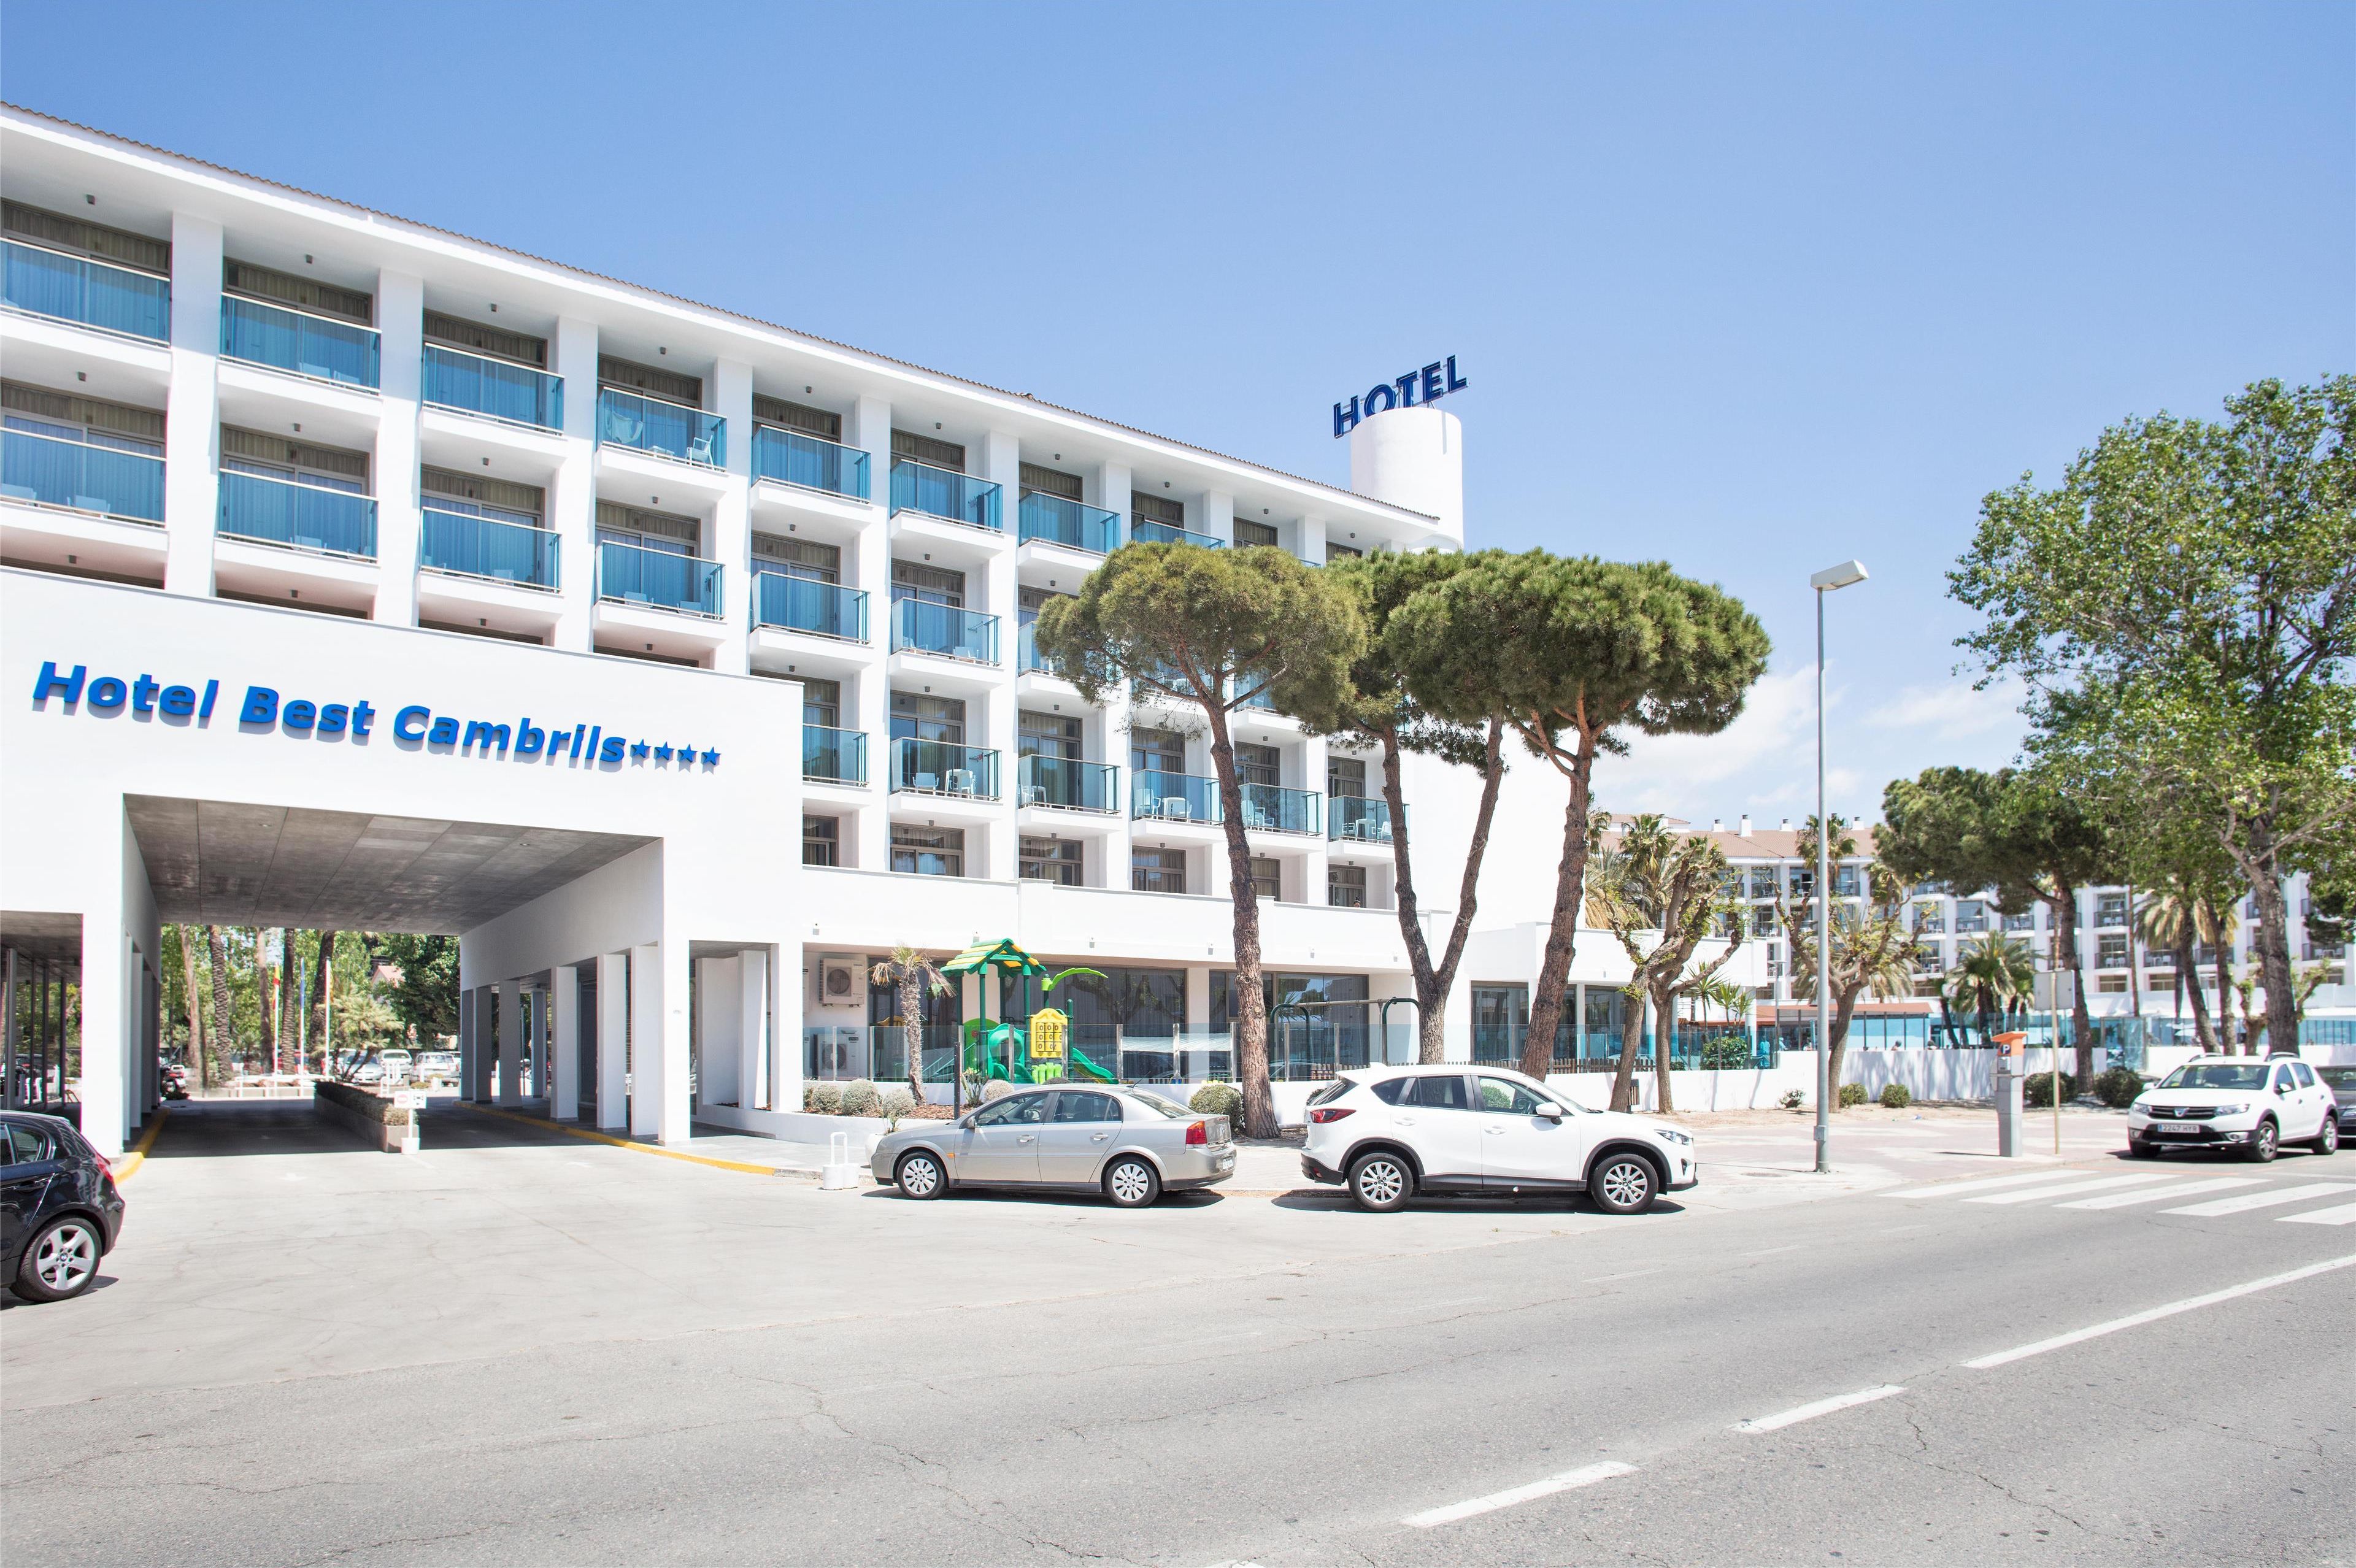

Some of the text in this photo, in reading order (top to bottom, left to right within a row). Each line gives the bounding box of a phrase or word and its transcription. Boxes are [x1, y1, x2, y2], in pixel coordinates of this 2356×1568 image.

[1333, 354, 1469, 439] HOTEL
[32, 661, 626, 763] Hotel Best Cambrils
[2003, 1044, 2010, 1054] P
